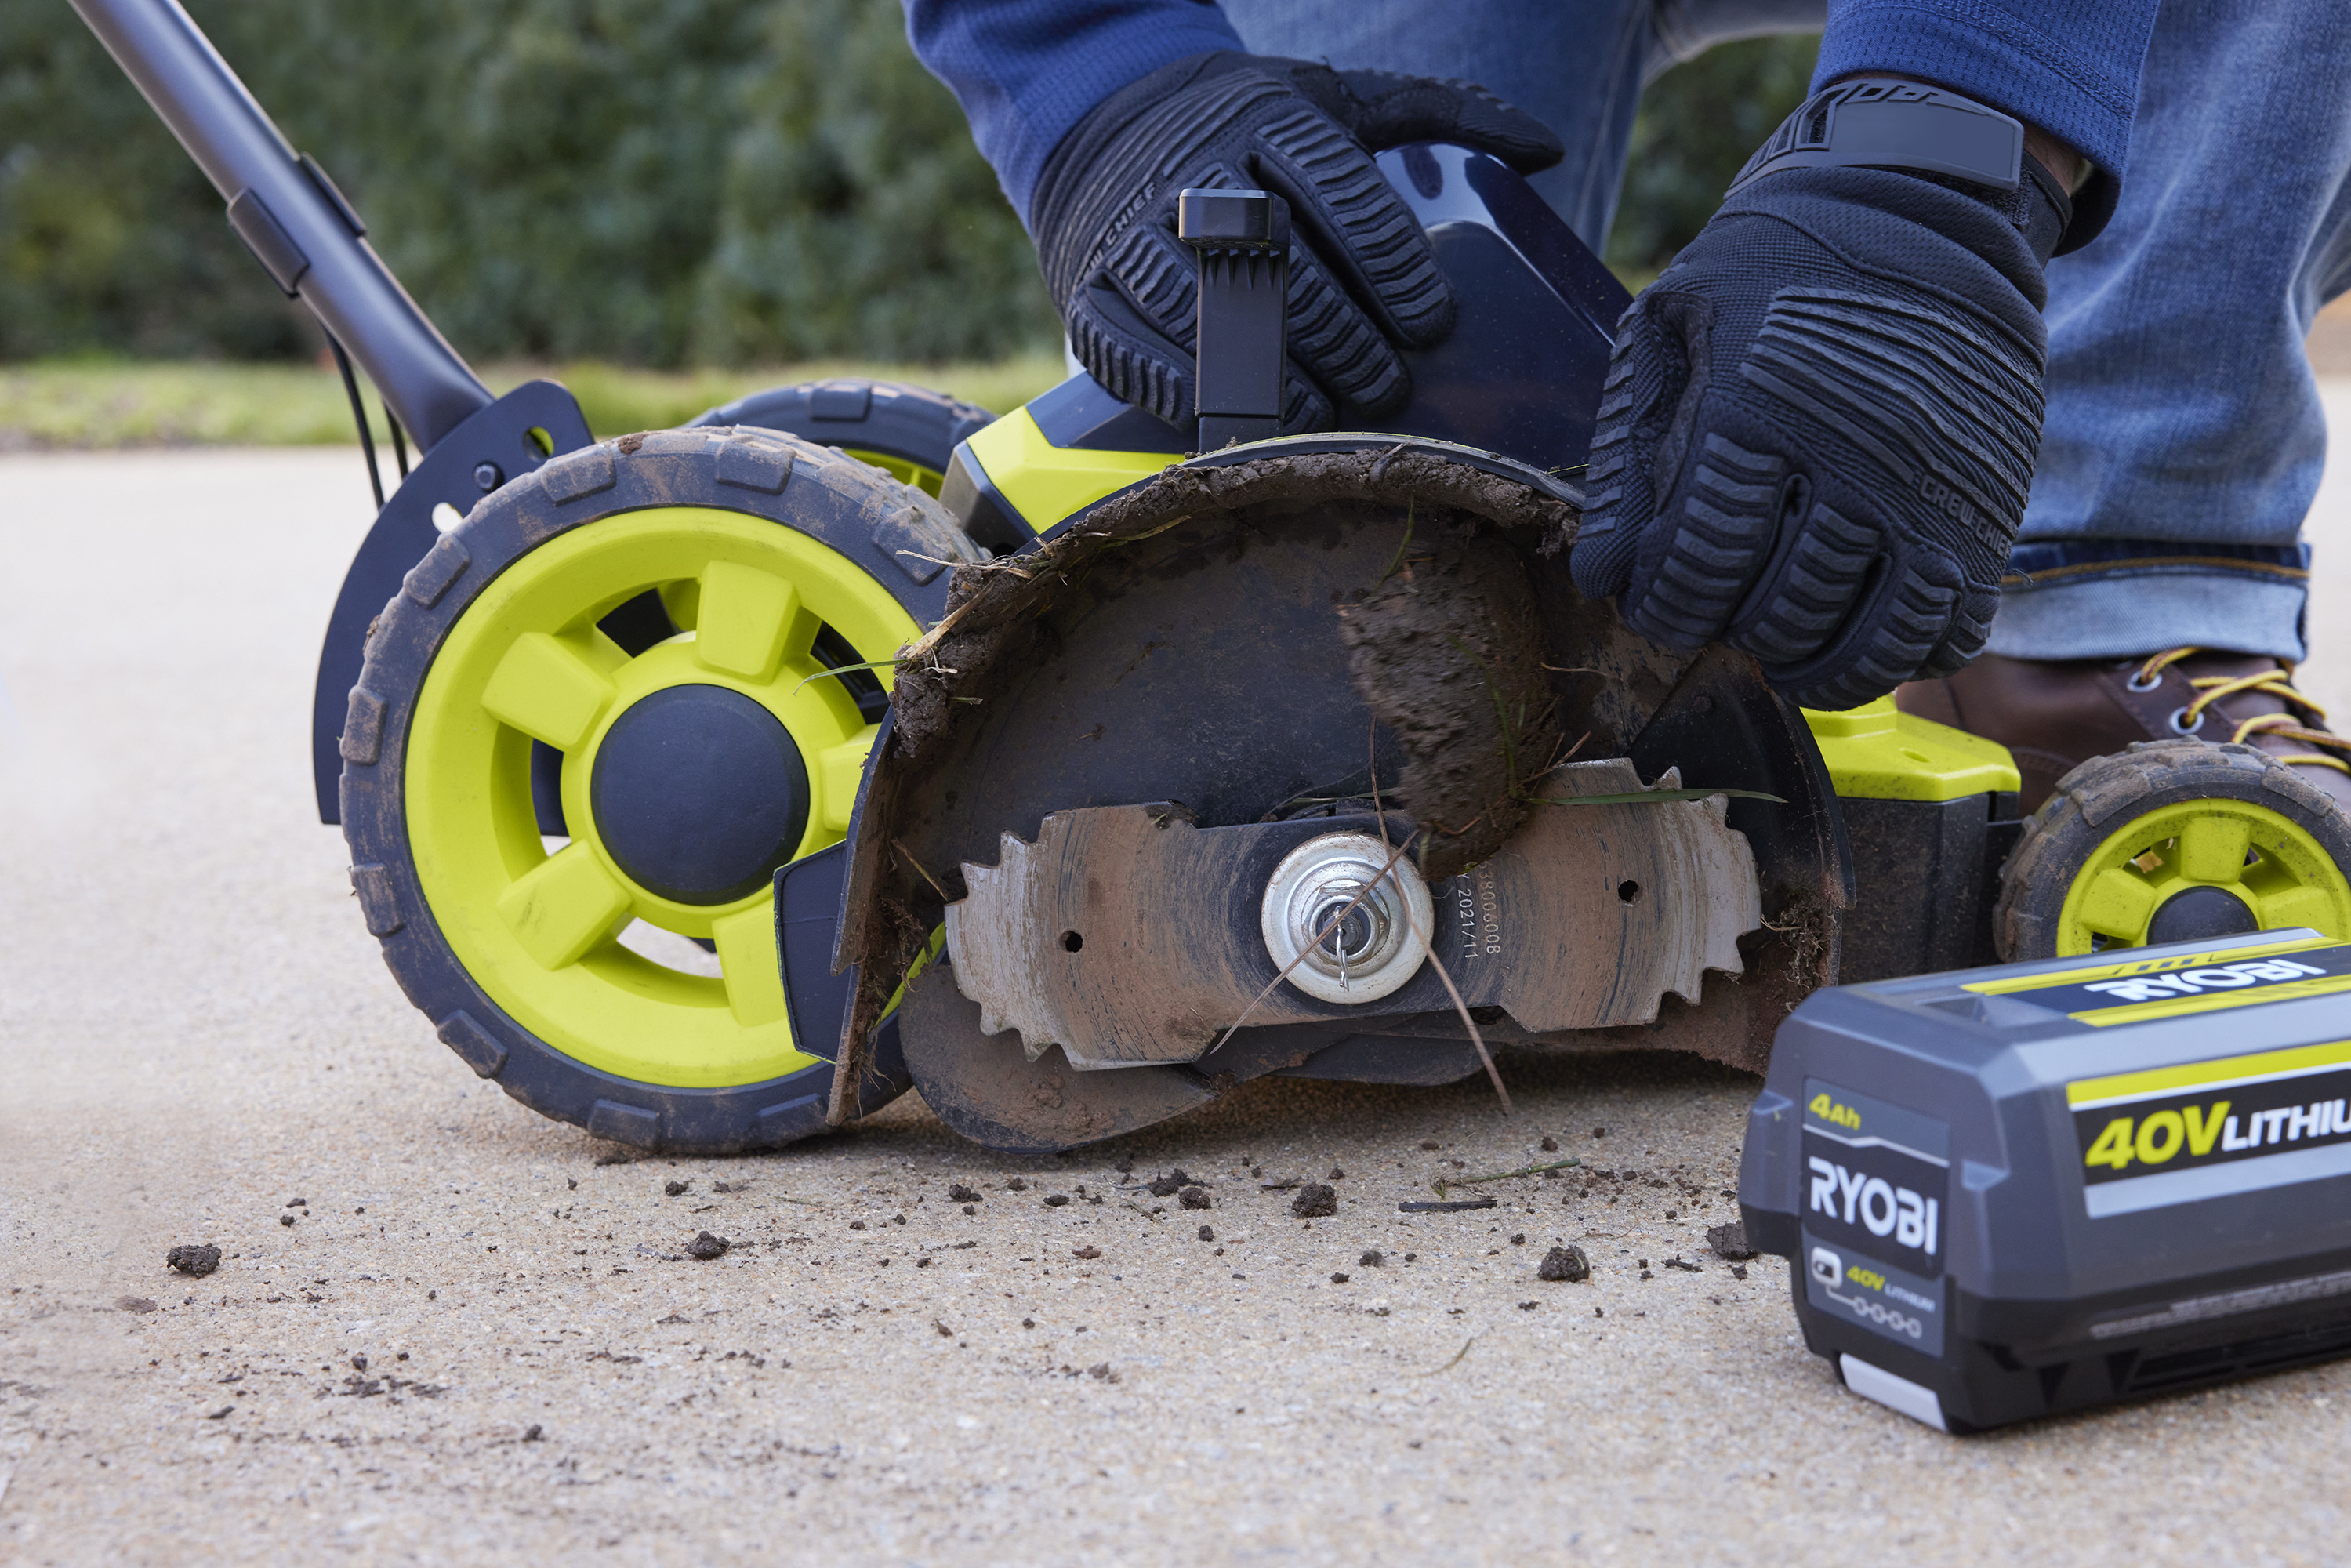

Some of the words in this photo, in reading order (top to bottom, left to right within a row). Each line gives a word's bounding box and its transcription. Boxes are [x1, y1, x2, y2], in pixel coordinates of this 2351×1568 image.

[1105, 181, 1156, 246] CHIEF
[1921, 474, 1975, 526] CREW
[1975, 517, 2012, 560] CHIEF
[1458, 888, 1478, 958] 2021/11
[2084, 959, 2327, 1001] RYOBI
[1809, 1093, 1862, 1131] 4Ah
[2085, 1100, 2232, 1170] 40V
[1809, 1155, 1939, 1256] RYOBI
[1846, 1265, 1886, 1292] 40V
